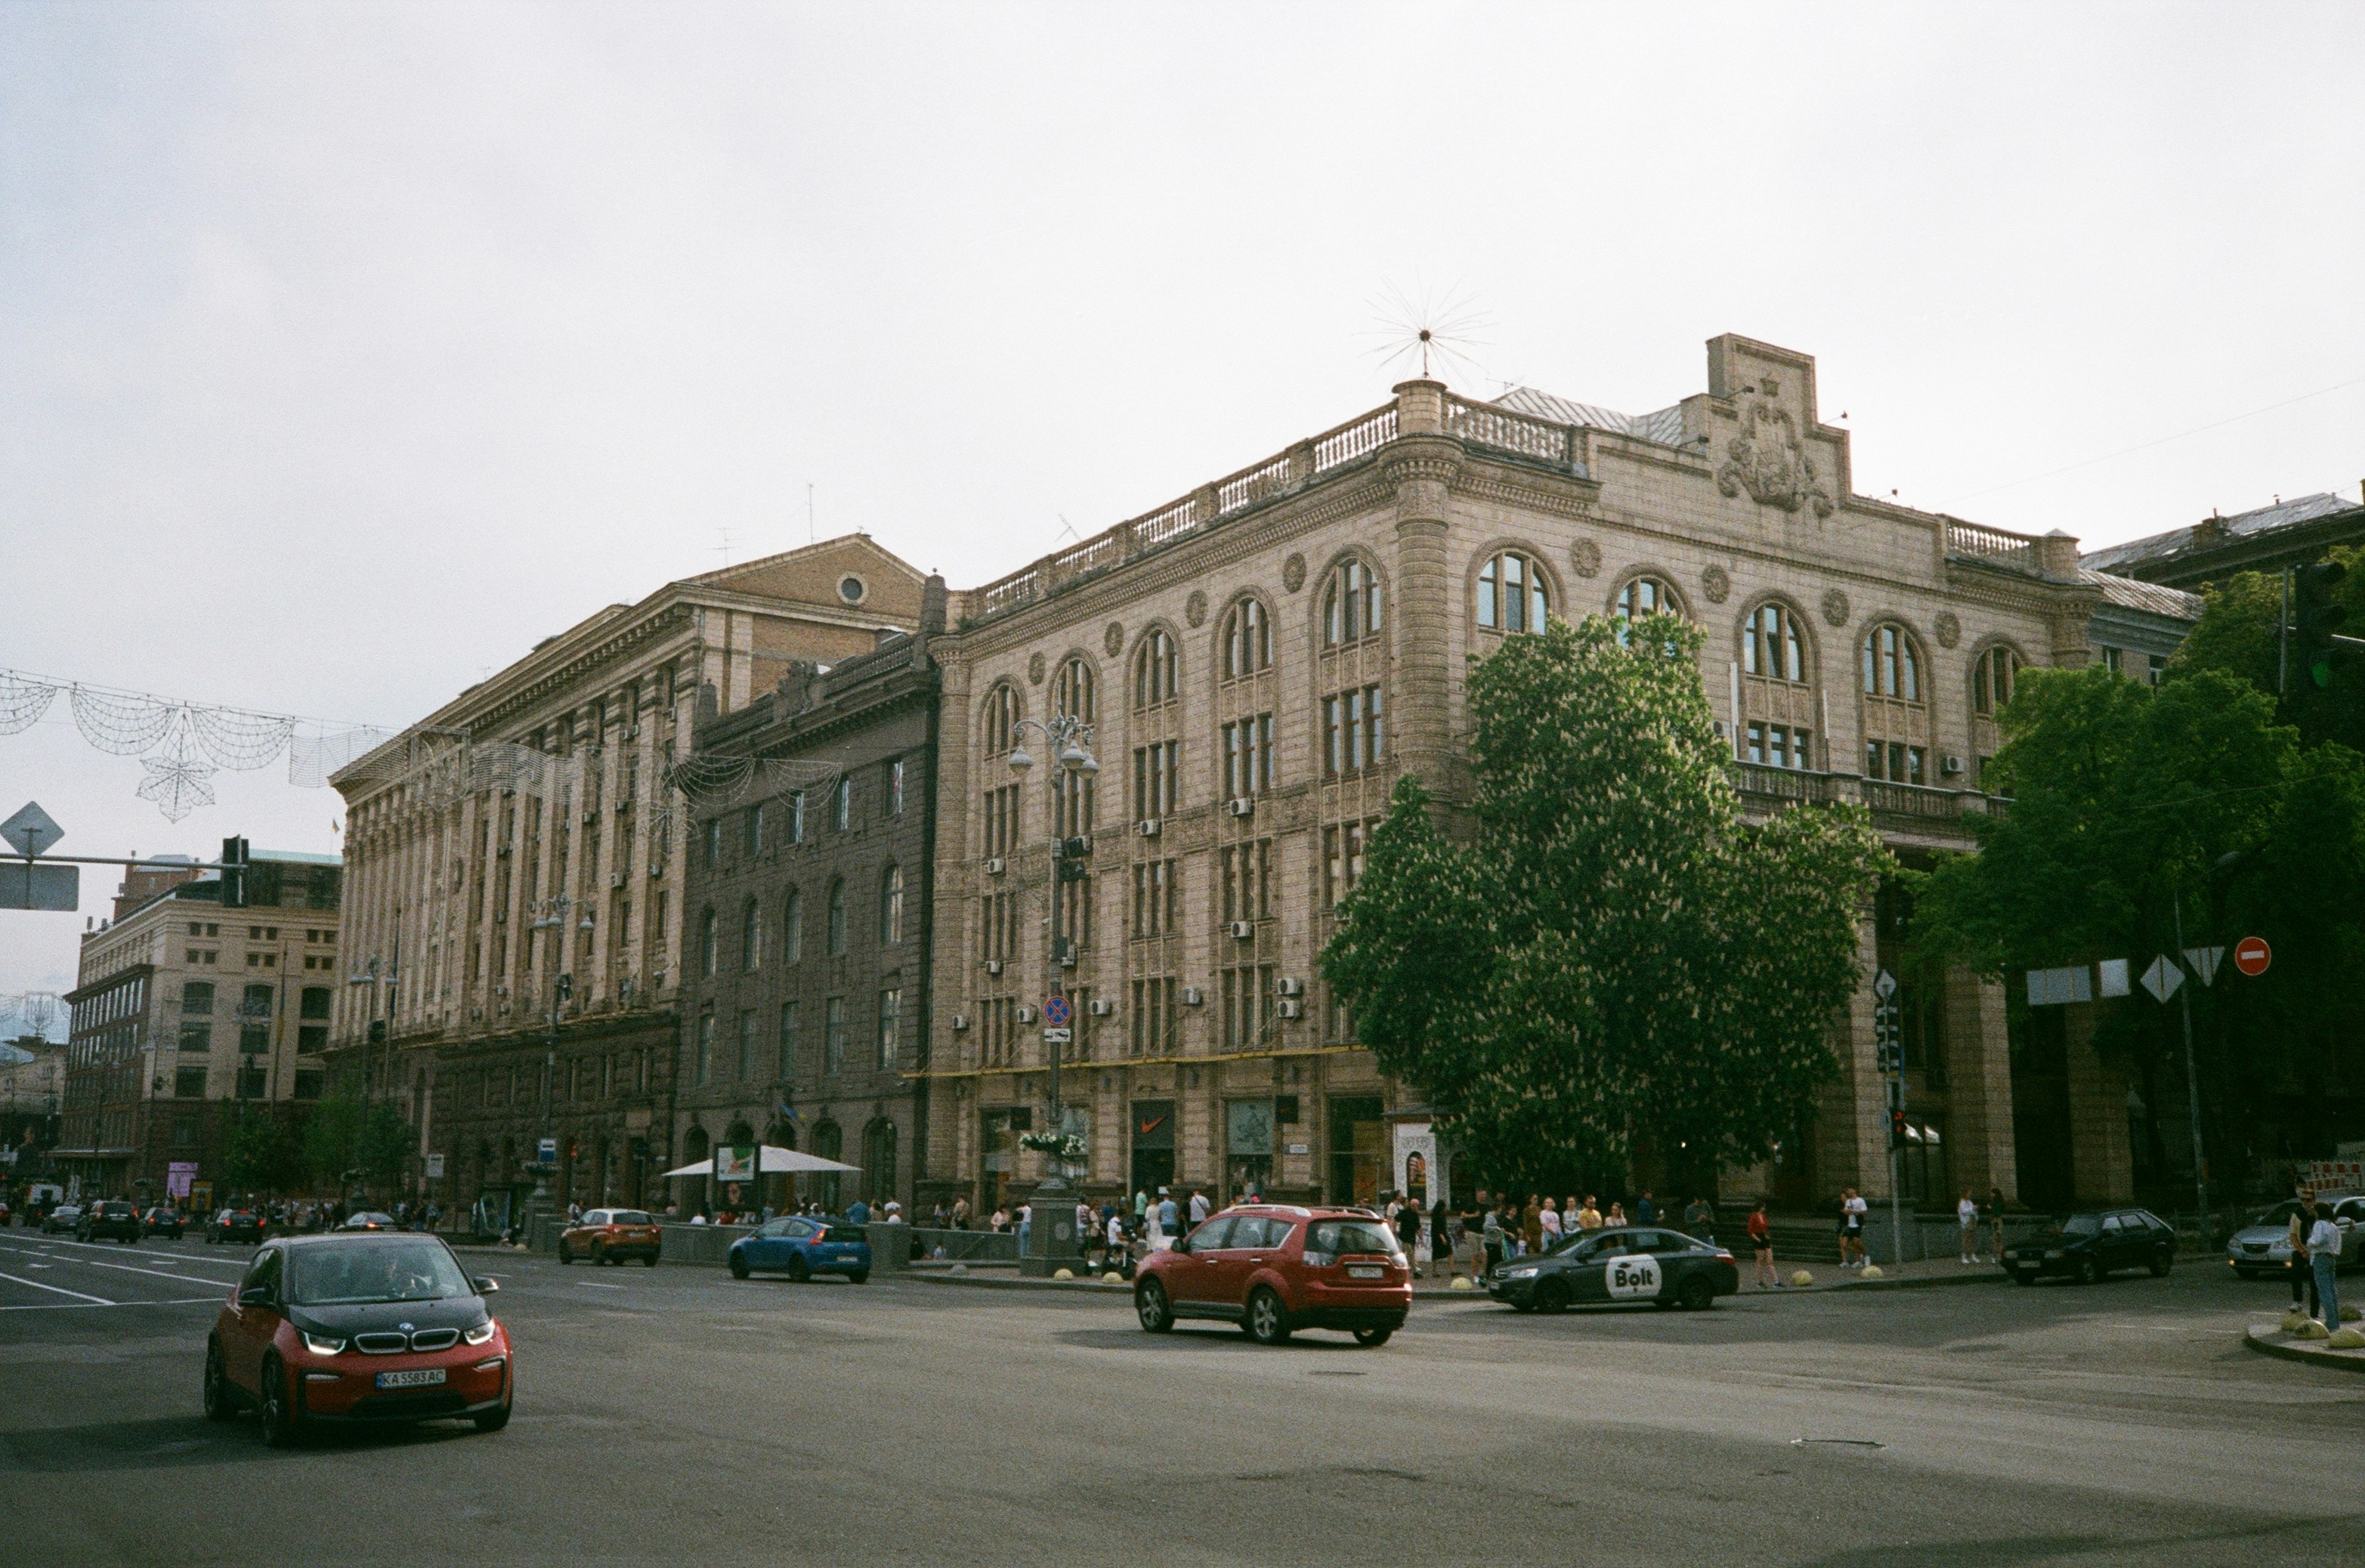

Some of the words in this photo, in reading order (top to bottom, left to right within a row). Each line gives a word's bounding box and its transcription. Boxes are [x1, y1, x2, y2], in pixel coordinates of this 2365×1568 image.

[1615, 1267, 1653, 1288] Bolt
[382, 1374, 399, 1385] KA
[401, 1372, 426, 1384] 5583
